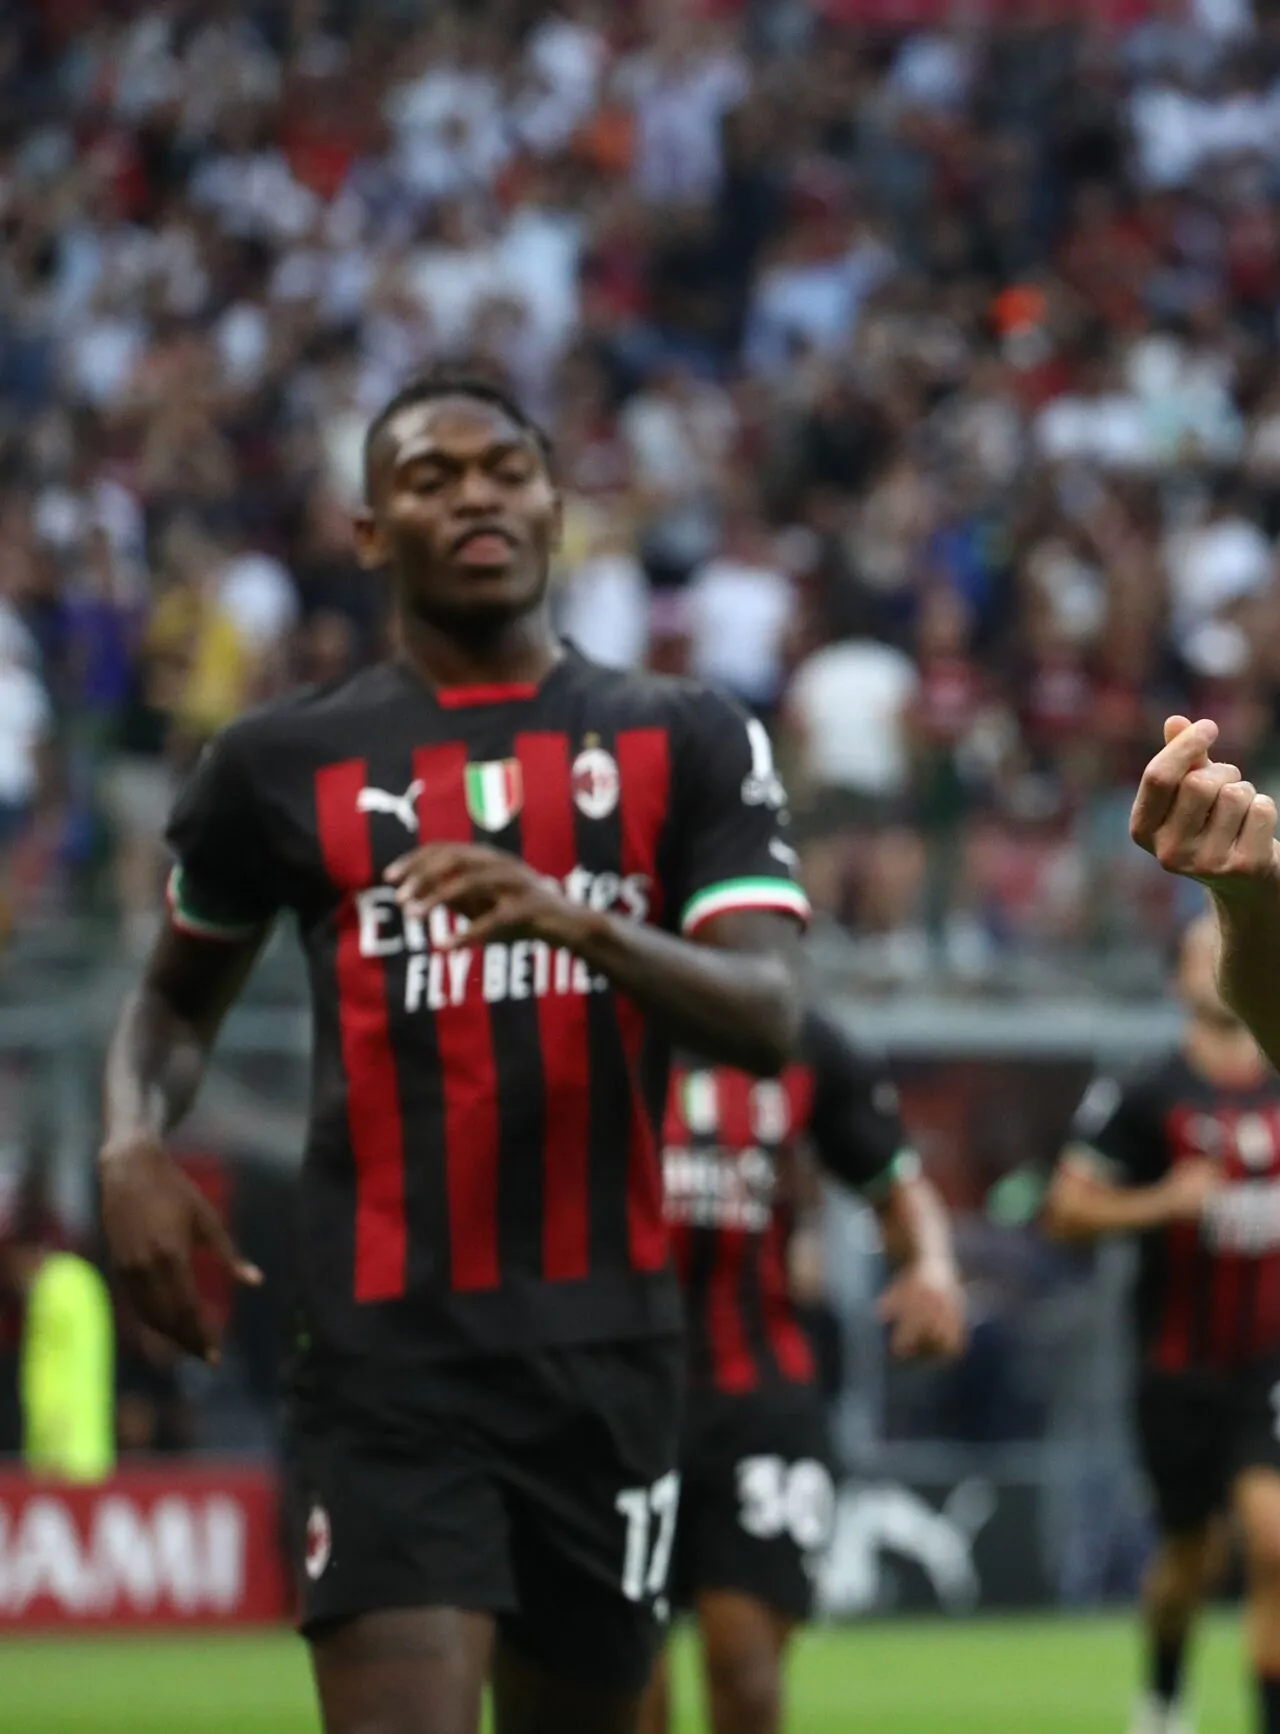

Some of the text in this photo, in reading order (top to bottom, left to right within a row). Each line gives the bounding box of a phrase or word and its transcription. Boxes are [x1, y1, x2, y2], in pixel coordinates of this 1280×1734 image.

[405, 940, 609, 1013] FLY BETTE
[0, 1493, 246, 1616] AMI
